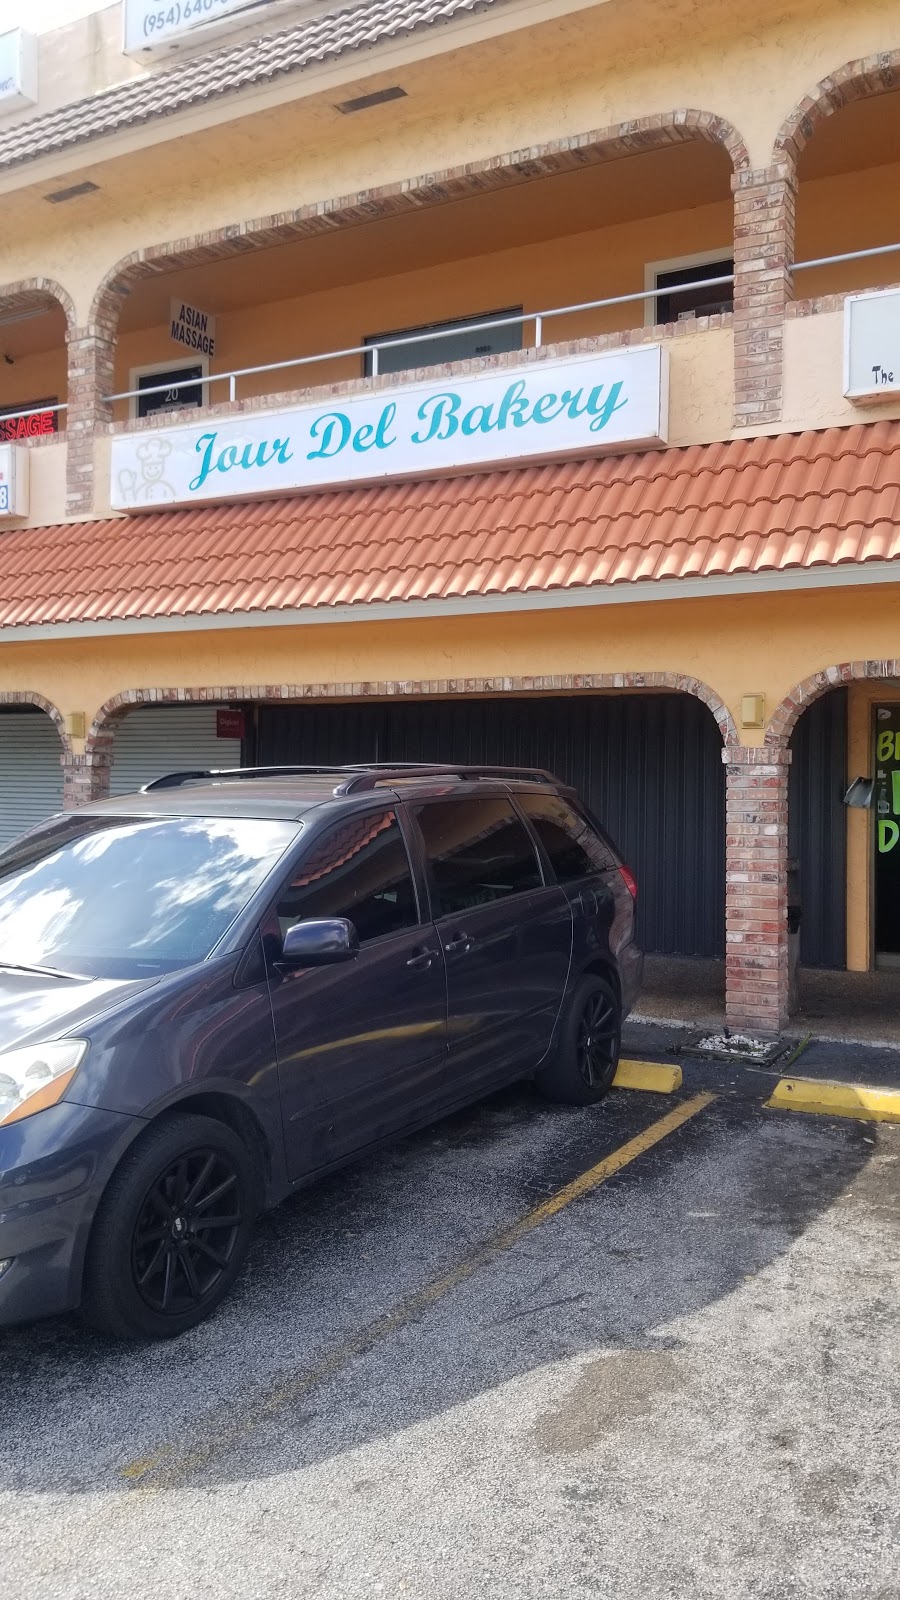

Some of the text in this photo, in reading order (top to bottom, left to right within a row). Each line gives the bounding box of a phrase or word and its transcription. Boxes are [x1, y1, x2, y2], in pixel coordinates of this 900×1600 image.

[179, 304, 208, 333] ASIAN
[170, 320, 215, 357] MASSAGE
[871, 365, 894, 385] The
[164, 388, 179, 402] 20
[188, 379, 629, 491] Jour Del Bakery
